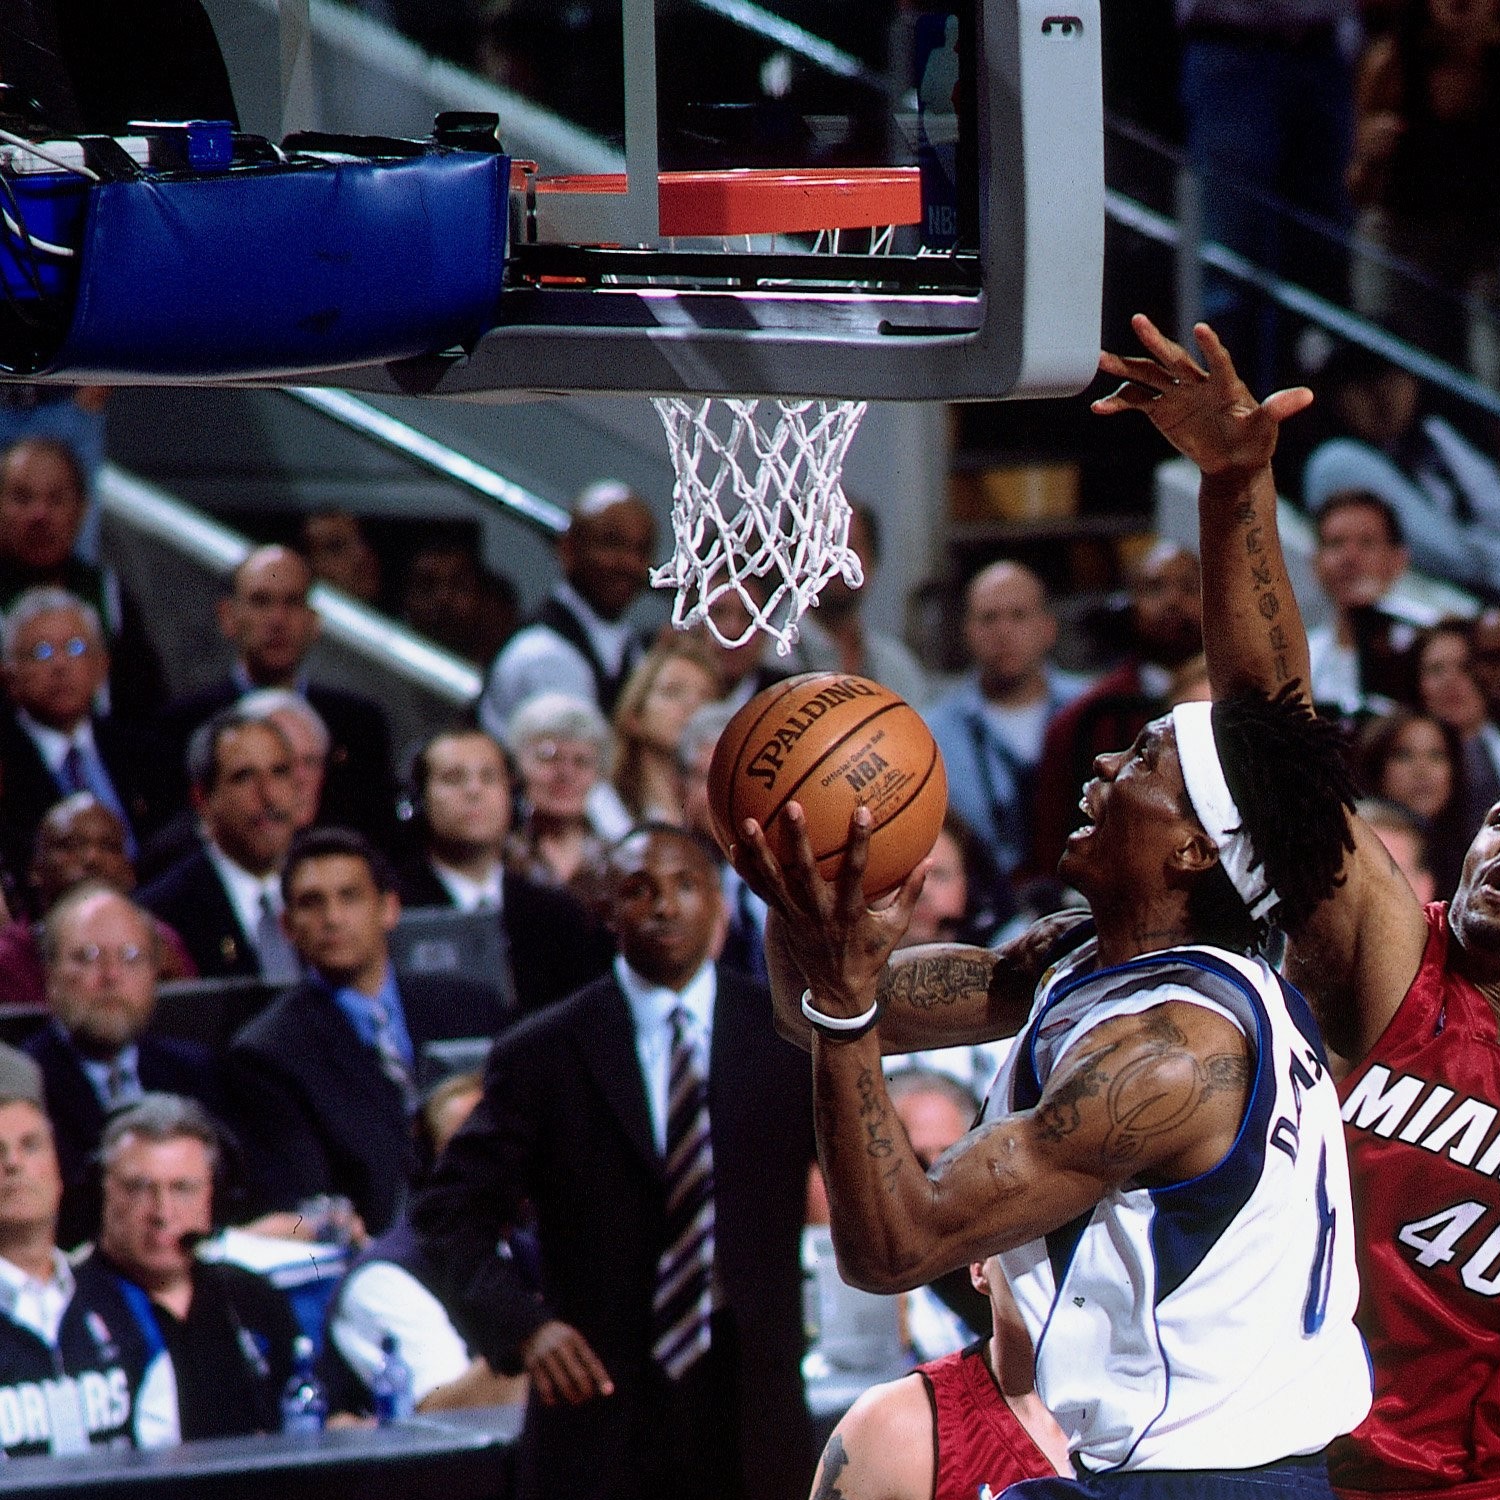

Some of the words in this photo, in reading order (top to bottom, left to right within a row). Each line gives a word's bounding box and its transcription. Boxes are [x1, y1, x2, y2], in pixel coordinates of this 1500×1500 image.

[928, 205, 957, 236] NB
[747, 677, 879, 791] SPALDING
[845, 752, 889, 792] NBA
